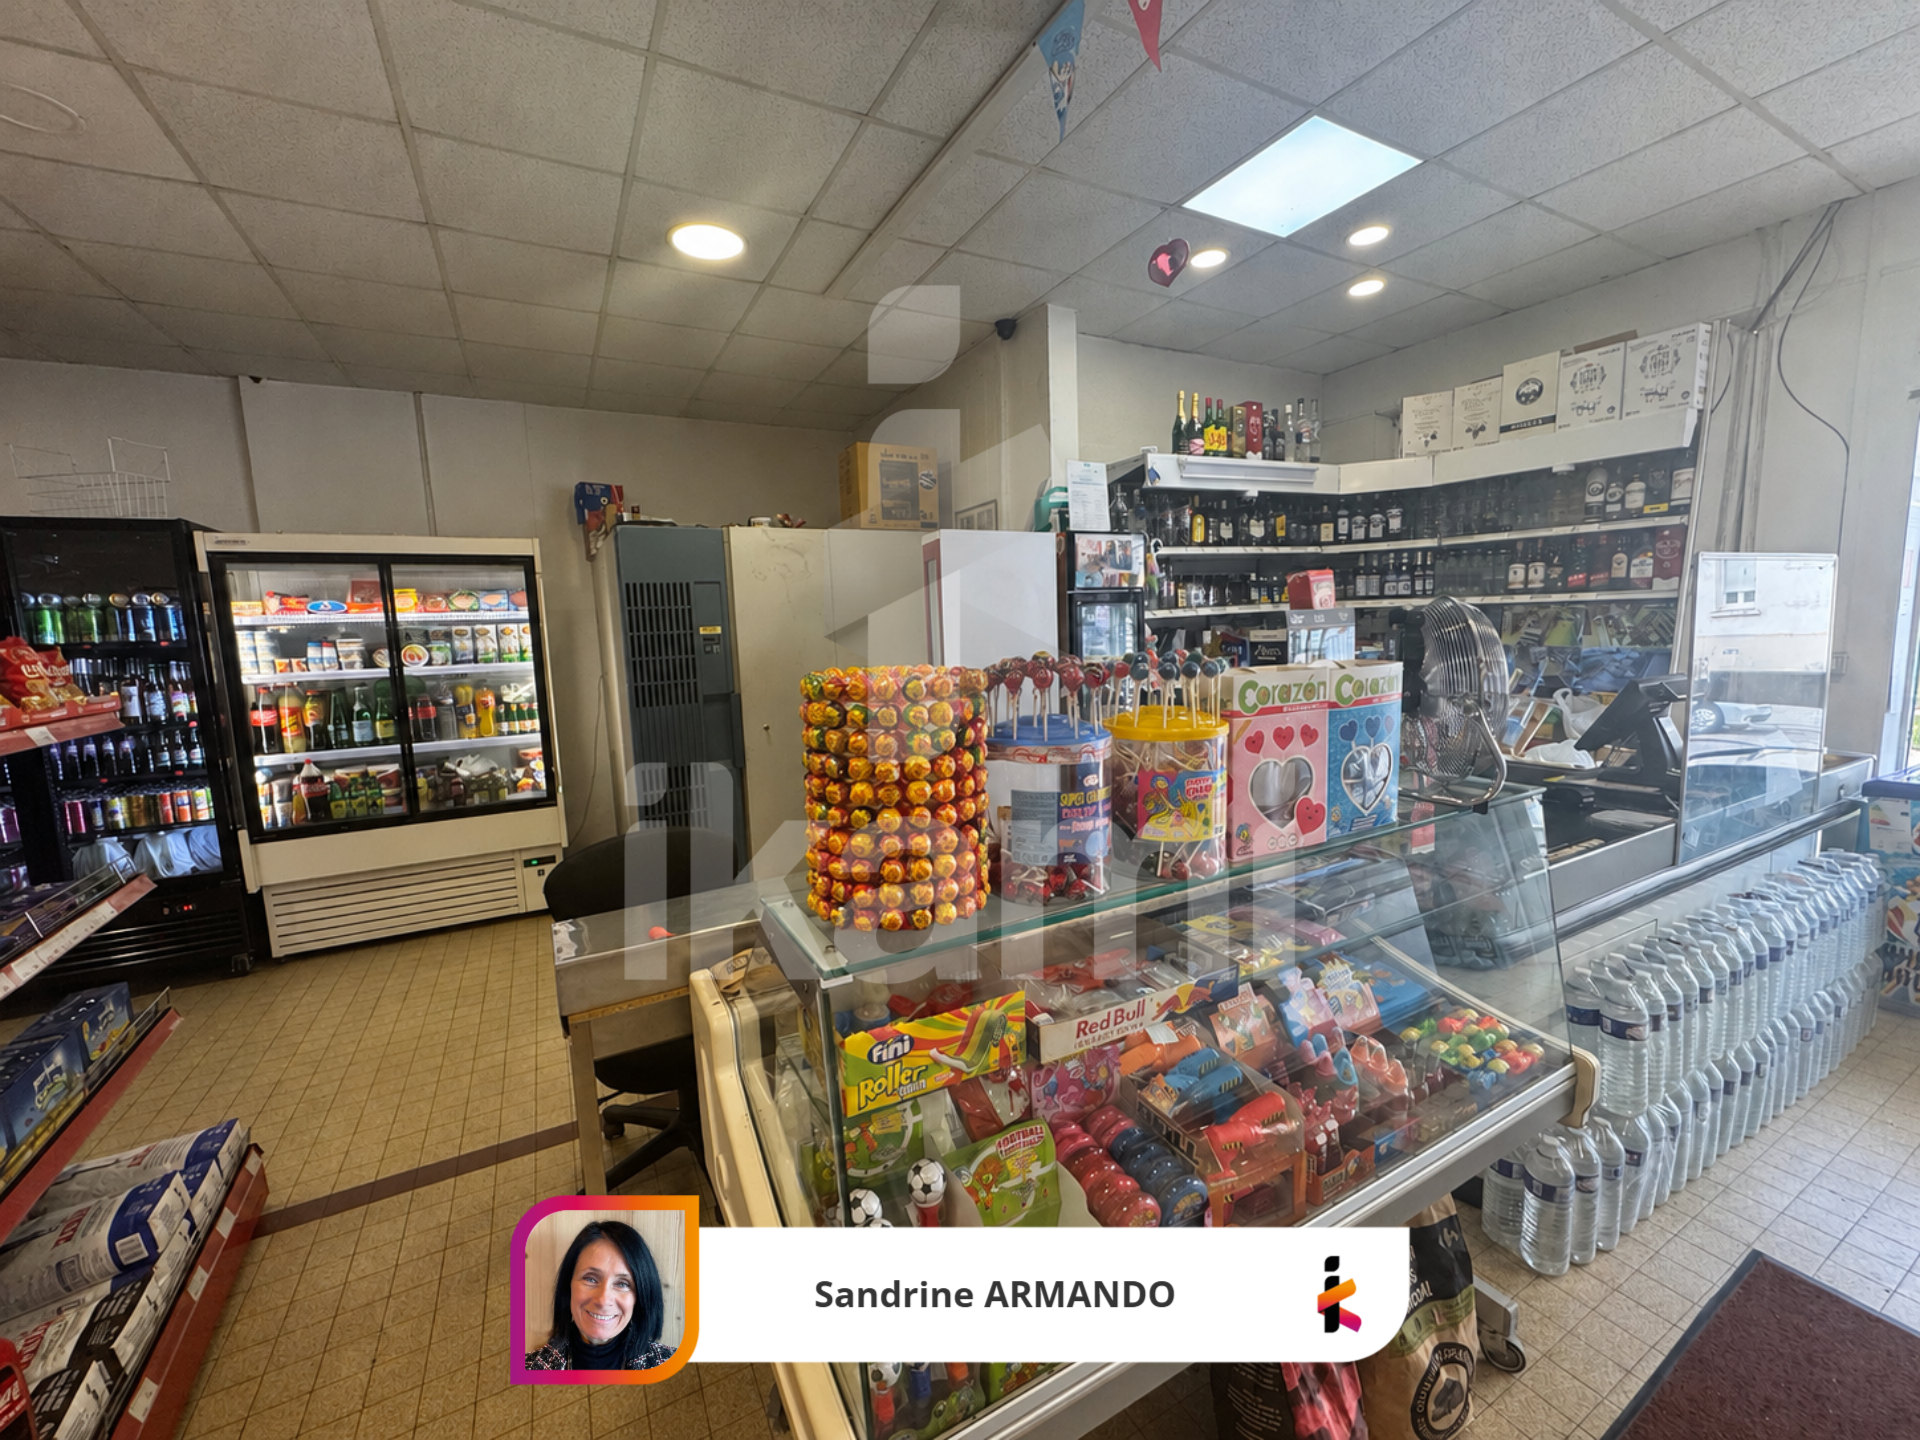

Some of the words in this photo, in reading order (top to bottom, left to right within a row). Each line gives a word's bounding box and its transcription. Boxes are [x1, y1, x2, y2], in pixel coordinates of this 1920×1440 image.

[1238, 674, 1327, 714] Corazón
[1076, 1009, 1117, 1038] Red
[1112, 999, 1146, 1030] Bull
[871, 1035, 912, 1063] Fini
[857, 1060, 928, 1114] Roller
